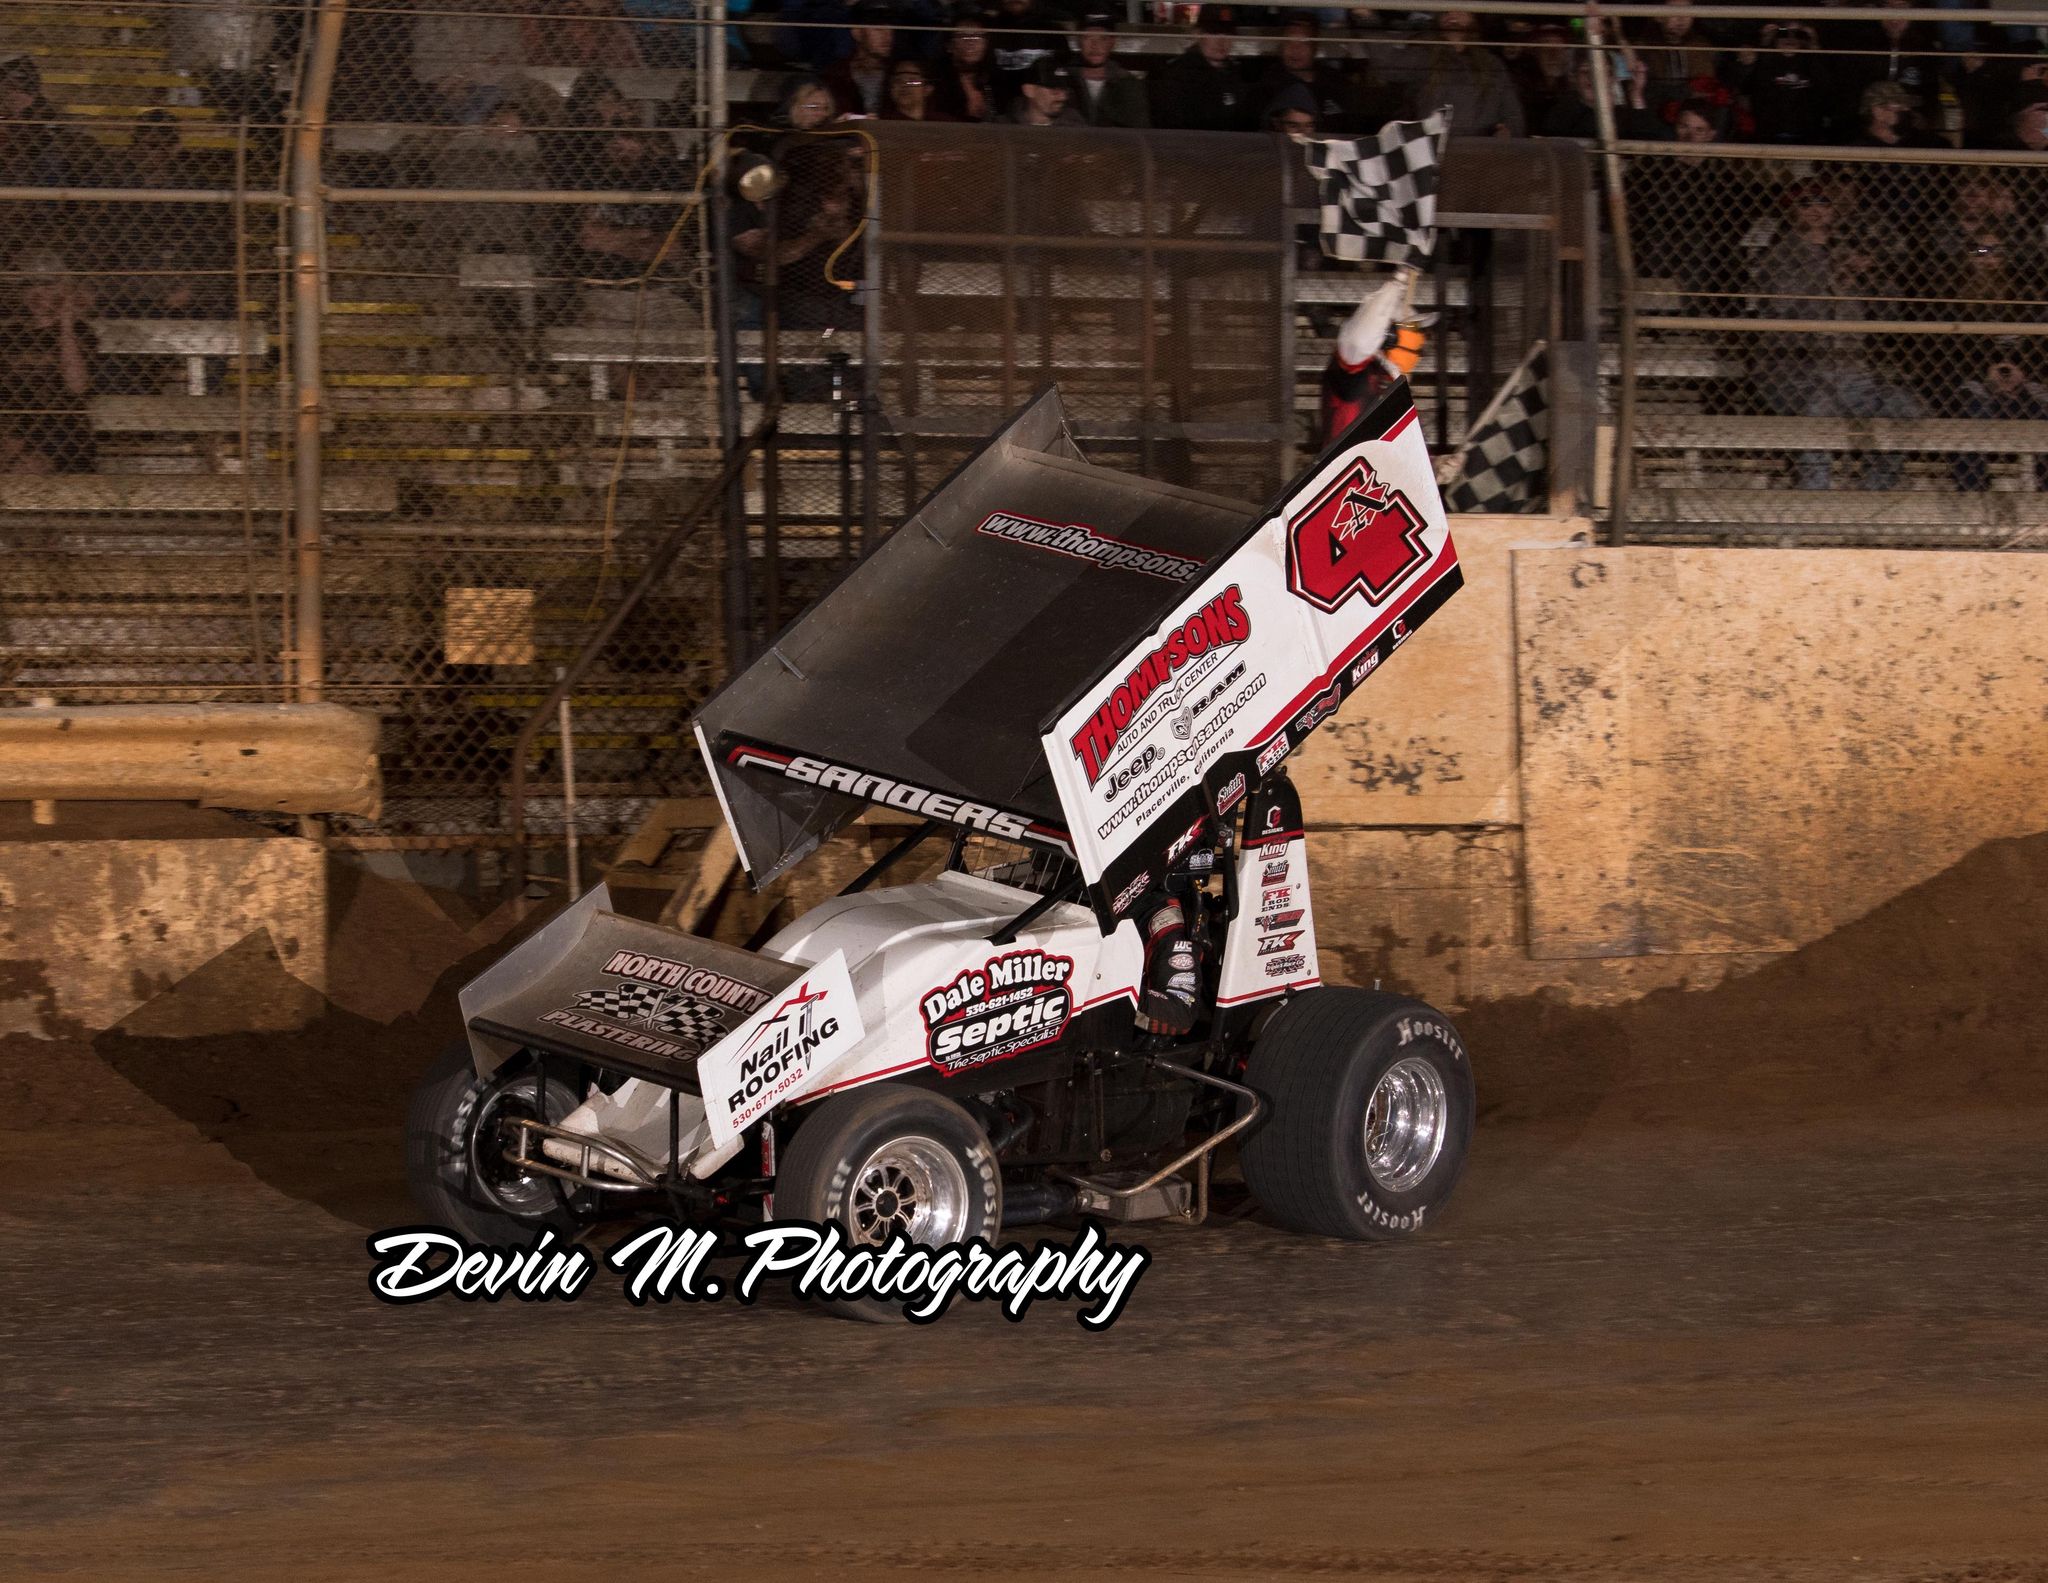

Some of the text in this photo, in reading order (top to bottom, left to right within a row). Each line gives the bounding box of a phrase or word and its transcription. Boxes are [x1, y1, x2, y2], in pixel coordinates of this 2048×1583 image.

[1075, 584, 1251, 790] THOMPSONS
[1191, 660, 1246, 719] RAM
[1352, 651, 1379, 684] King
[1117, 653, 1218, 755] AUTO AND TRUCK CENTER
[1098, 673, 1266, 839] www.thompsonsauto.com
[1104, 744, 1158, 802] Jeep
[1135, 775, 1190, 826] Placerville,
[1194, 728, 1234, 775] California
[784, 756, 1035, 841] SANDERS
[1219, 773, 1243, 802] Smith
[1260, 842, 1288, 857] King
[1263, 860, 1288, 876] Smith
[1261, 903, 1290, 912] ENDS
[1264, 888, 1291, 900] FK
[1267, 897, 1290, 906] ROD
[604, 952, 772, 1014] NORTH COUNTY
[924, 955, 1070, 1024] Dale Miller
[965, 986, 1034, 1017] 530-621-1452
[541, 1010, 697, 1061] PLASTERING
[740, 1025, 789, 1084] Nail
[948, 1057, 969, 1071] The
[968, 1045, 1005, 1066] Septic
[1004, 1026, 1061, 1055] Specialist
[1396, 1017, 1463, 1061] Hoosier
[728, 1017, 840, 1114] ROOFING
[1356, 1191, 1427, 1233] Hoosier
